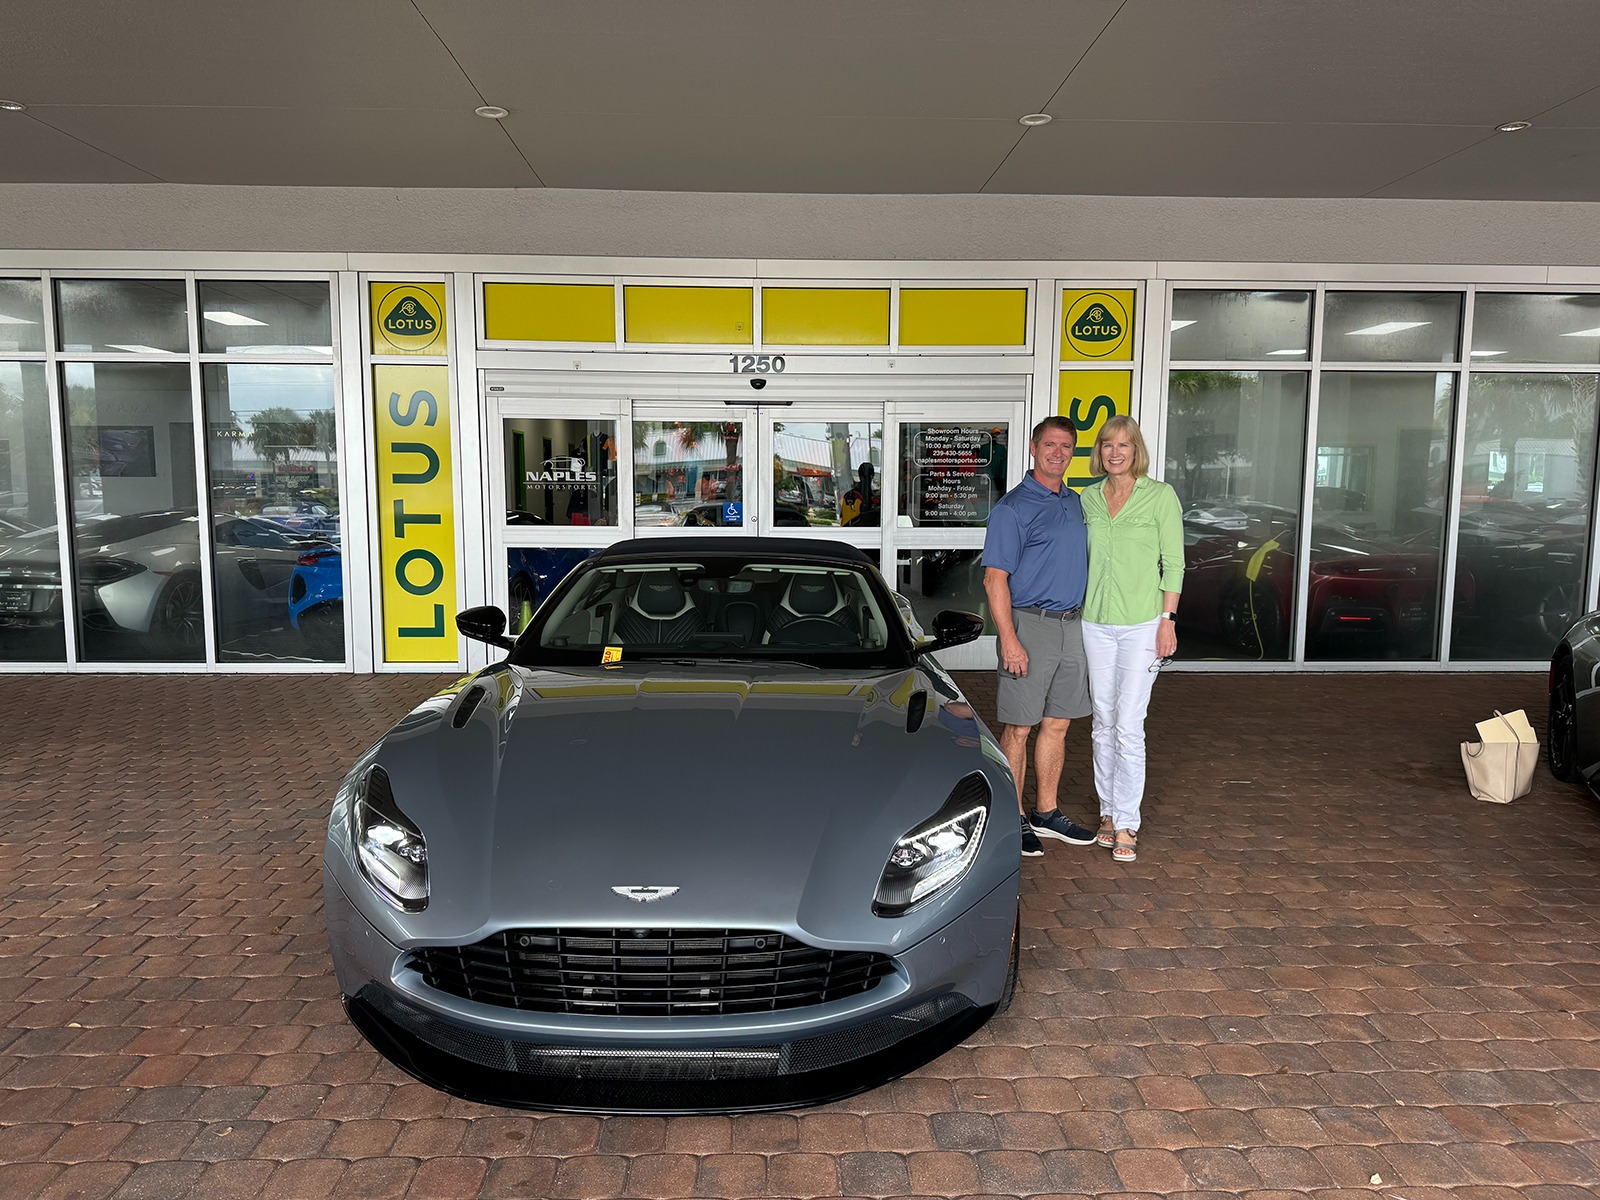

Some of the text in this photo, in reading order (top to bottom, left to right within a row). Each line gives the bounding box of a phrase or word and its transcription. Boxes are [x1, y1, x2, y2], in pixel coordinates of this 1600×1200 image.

[388, 318, 433, 330] LOTUS
[1075, 325, 1119, 336] LOTUS
[729, 355, 786, 373] 1250
[216, 430, 254, 438] KARMA
[526, 471, 597, 482] NAPLES
[389, 390, 445, 637] LOTUS
